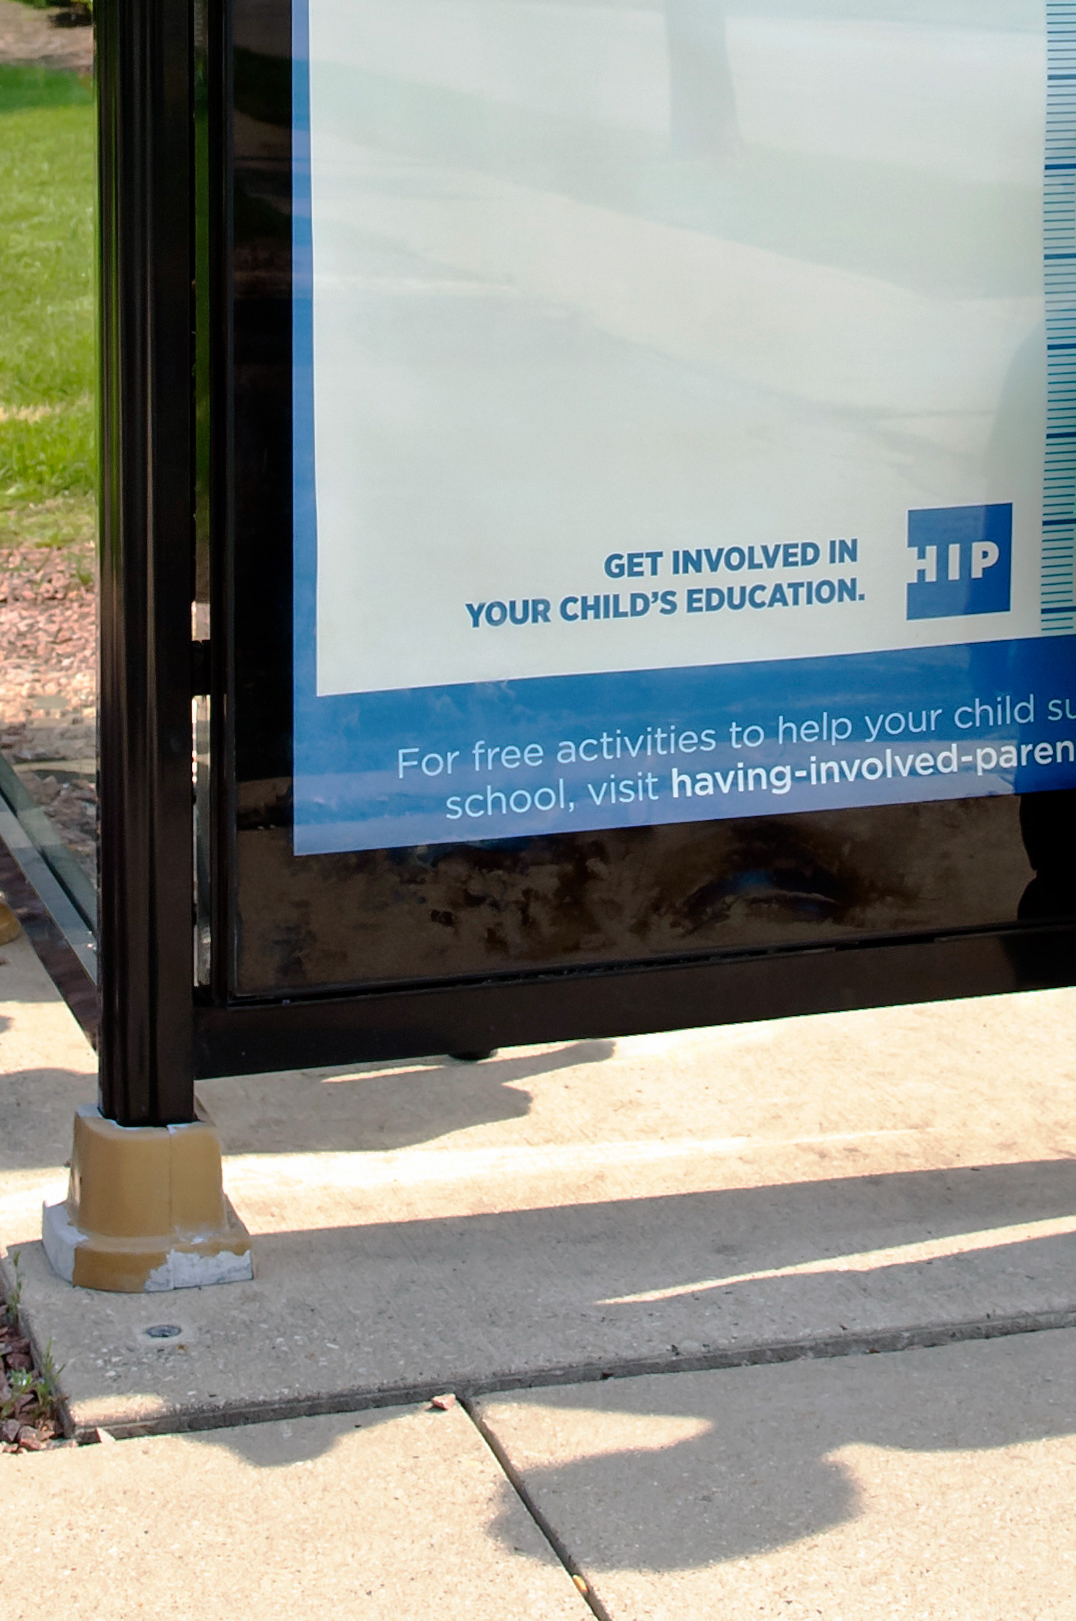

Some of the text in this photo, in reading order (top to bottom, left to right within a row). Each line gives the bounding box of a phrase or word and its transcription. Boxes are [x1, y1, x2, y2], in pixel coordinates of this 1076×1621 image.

[605, 539, 857, 578] GET INVOLVED IN
[906, 541, 999, 583] HIP
[466, 580, 865, 627] YOUR CHILD'S EDUCATION.
[398, 748, 459, 779] For
[472, 741, 543, 772] free
[557, 724, 716, 763] activities
[730, 722, 766, 750] to
[777, 711, 853, 746] help
[864, 709, 941, 738] your
[955, 694, 1034, 728] child
[445, 786, 575, 820] school,
[588, 770, 659, 805] visit
